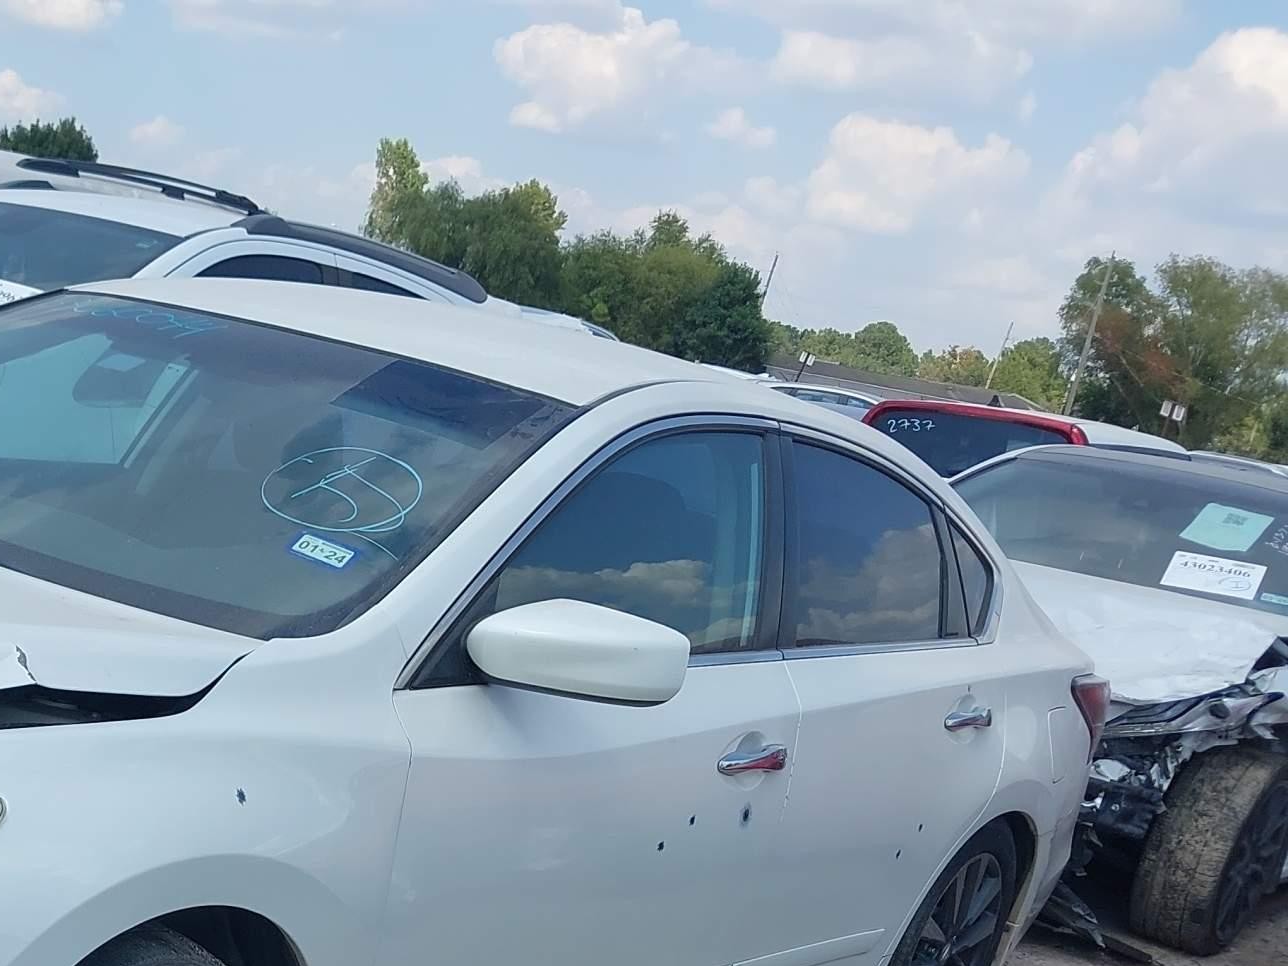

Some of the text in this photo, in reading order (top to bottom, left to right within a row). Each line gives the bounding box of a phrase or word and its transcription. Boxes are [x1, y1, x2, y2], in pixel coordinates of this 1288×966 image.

[887, 418, 936, 433] 2737
[298, 540, 319, 553] 01
[323, 550, 347, 564] 24
[1179, 560, 1251, 578] 43023406
